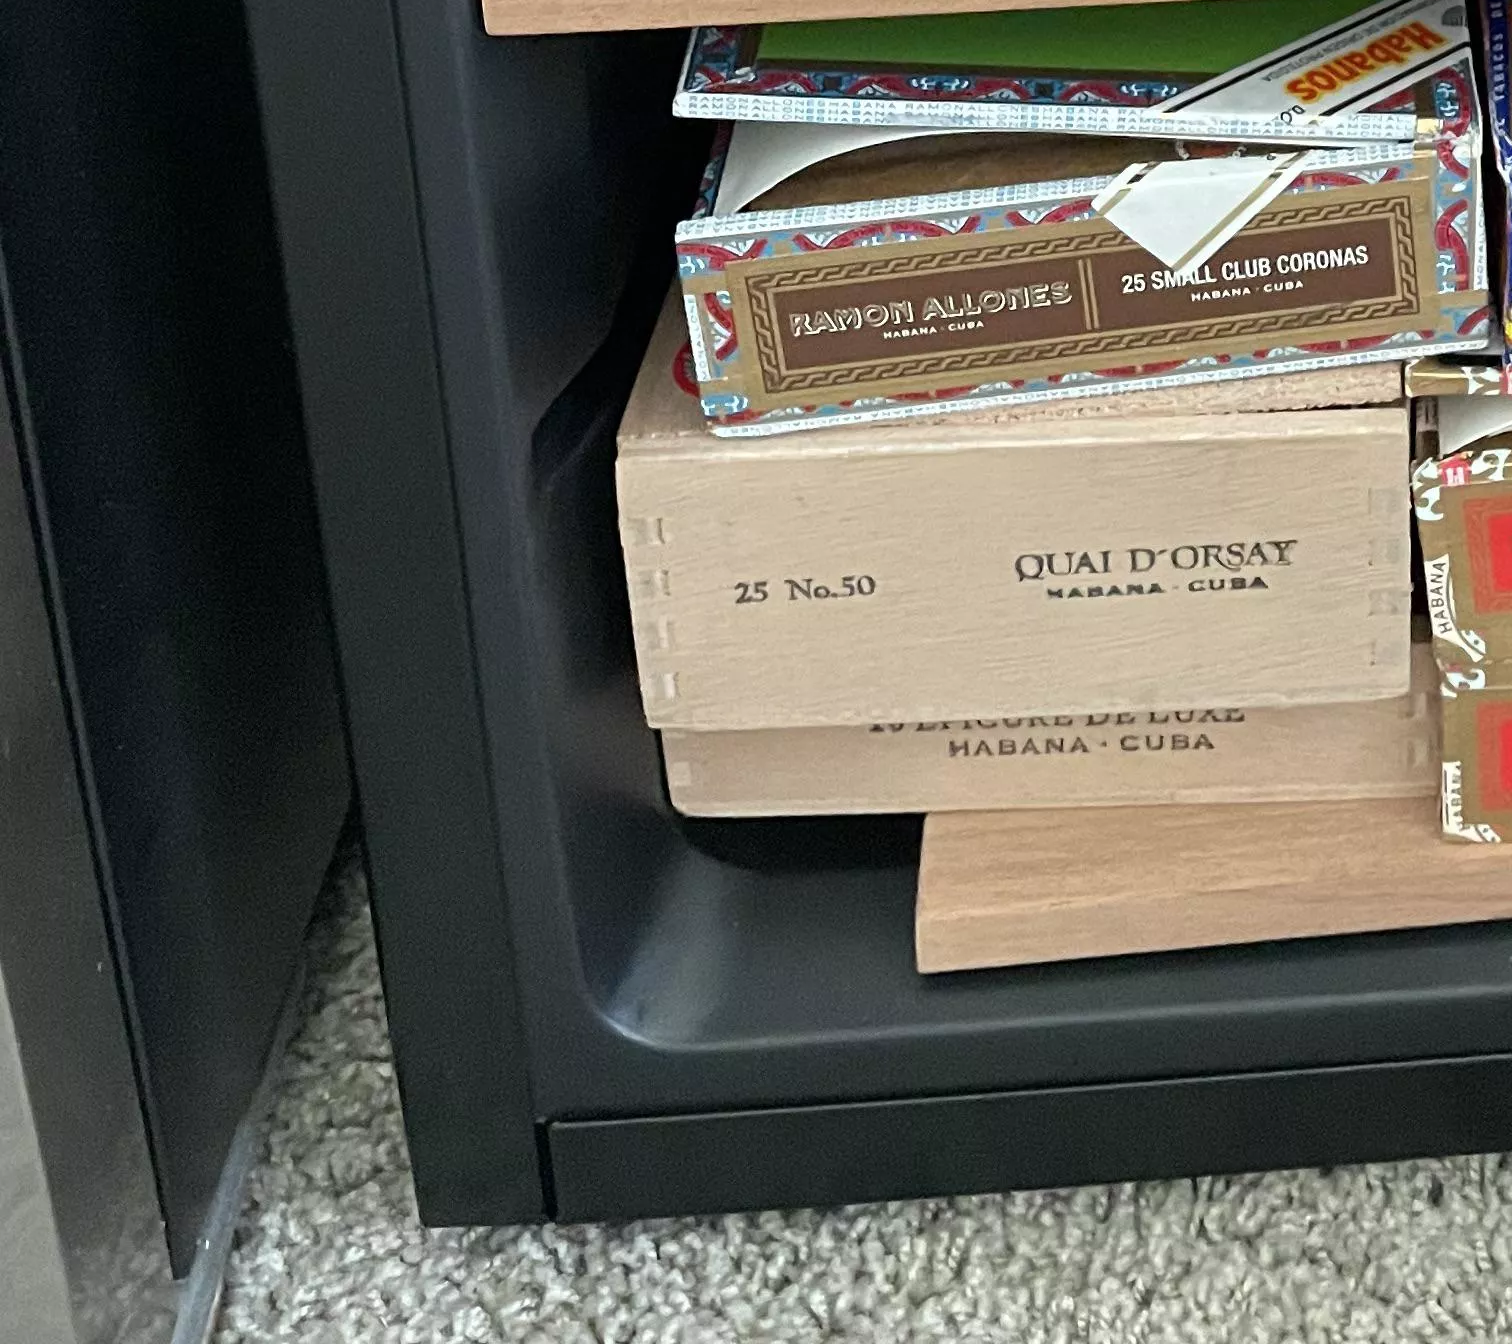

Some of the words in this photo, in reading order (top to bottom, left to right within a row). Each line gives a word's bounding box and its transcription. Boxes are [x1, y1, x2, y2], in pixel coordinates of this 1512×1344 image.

[1286, 21, 1447, 103] Habanos
[1121, 273, 1146, 293] 25
[1151, 262, 1217, 289] SMALL
[1221, 258, 1271, 281] CLUB
[1276, 245, 1368, 275] CORONAS
[1191, 287, 1250, 302] HABANA
[1263, 280, 1304, 293] CUBA
[789, 299, 914, 337] RAMON
[922, 280, 1073, 321] ALLONES
[883, 325, 937, 339] HABANA
[948, 320, 984, 333] CUBA
[1014, 550, 1112, 583] QUAI
[733, 581, 769, 605] 25
[787, 574, 877, 602] No.50
[1047, 583, 1166, 600] HABANA
[1188, 576, 1269, 592] CUBA
[1429, 561, 1452, 634] HABANA
[948, 736, 1091, 757] HABANA
[1119, 733, 1215, 752] CUBA
